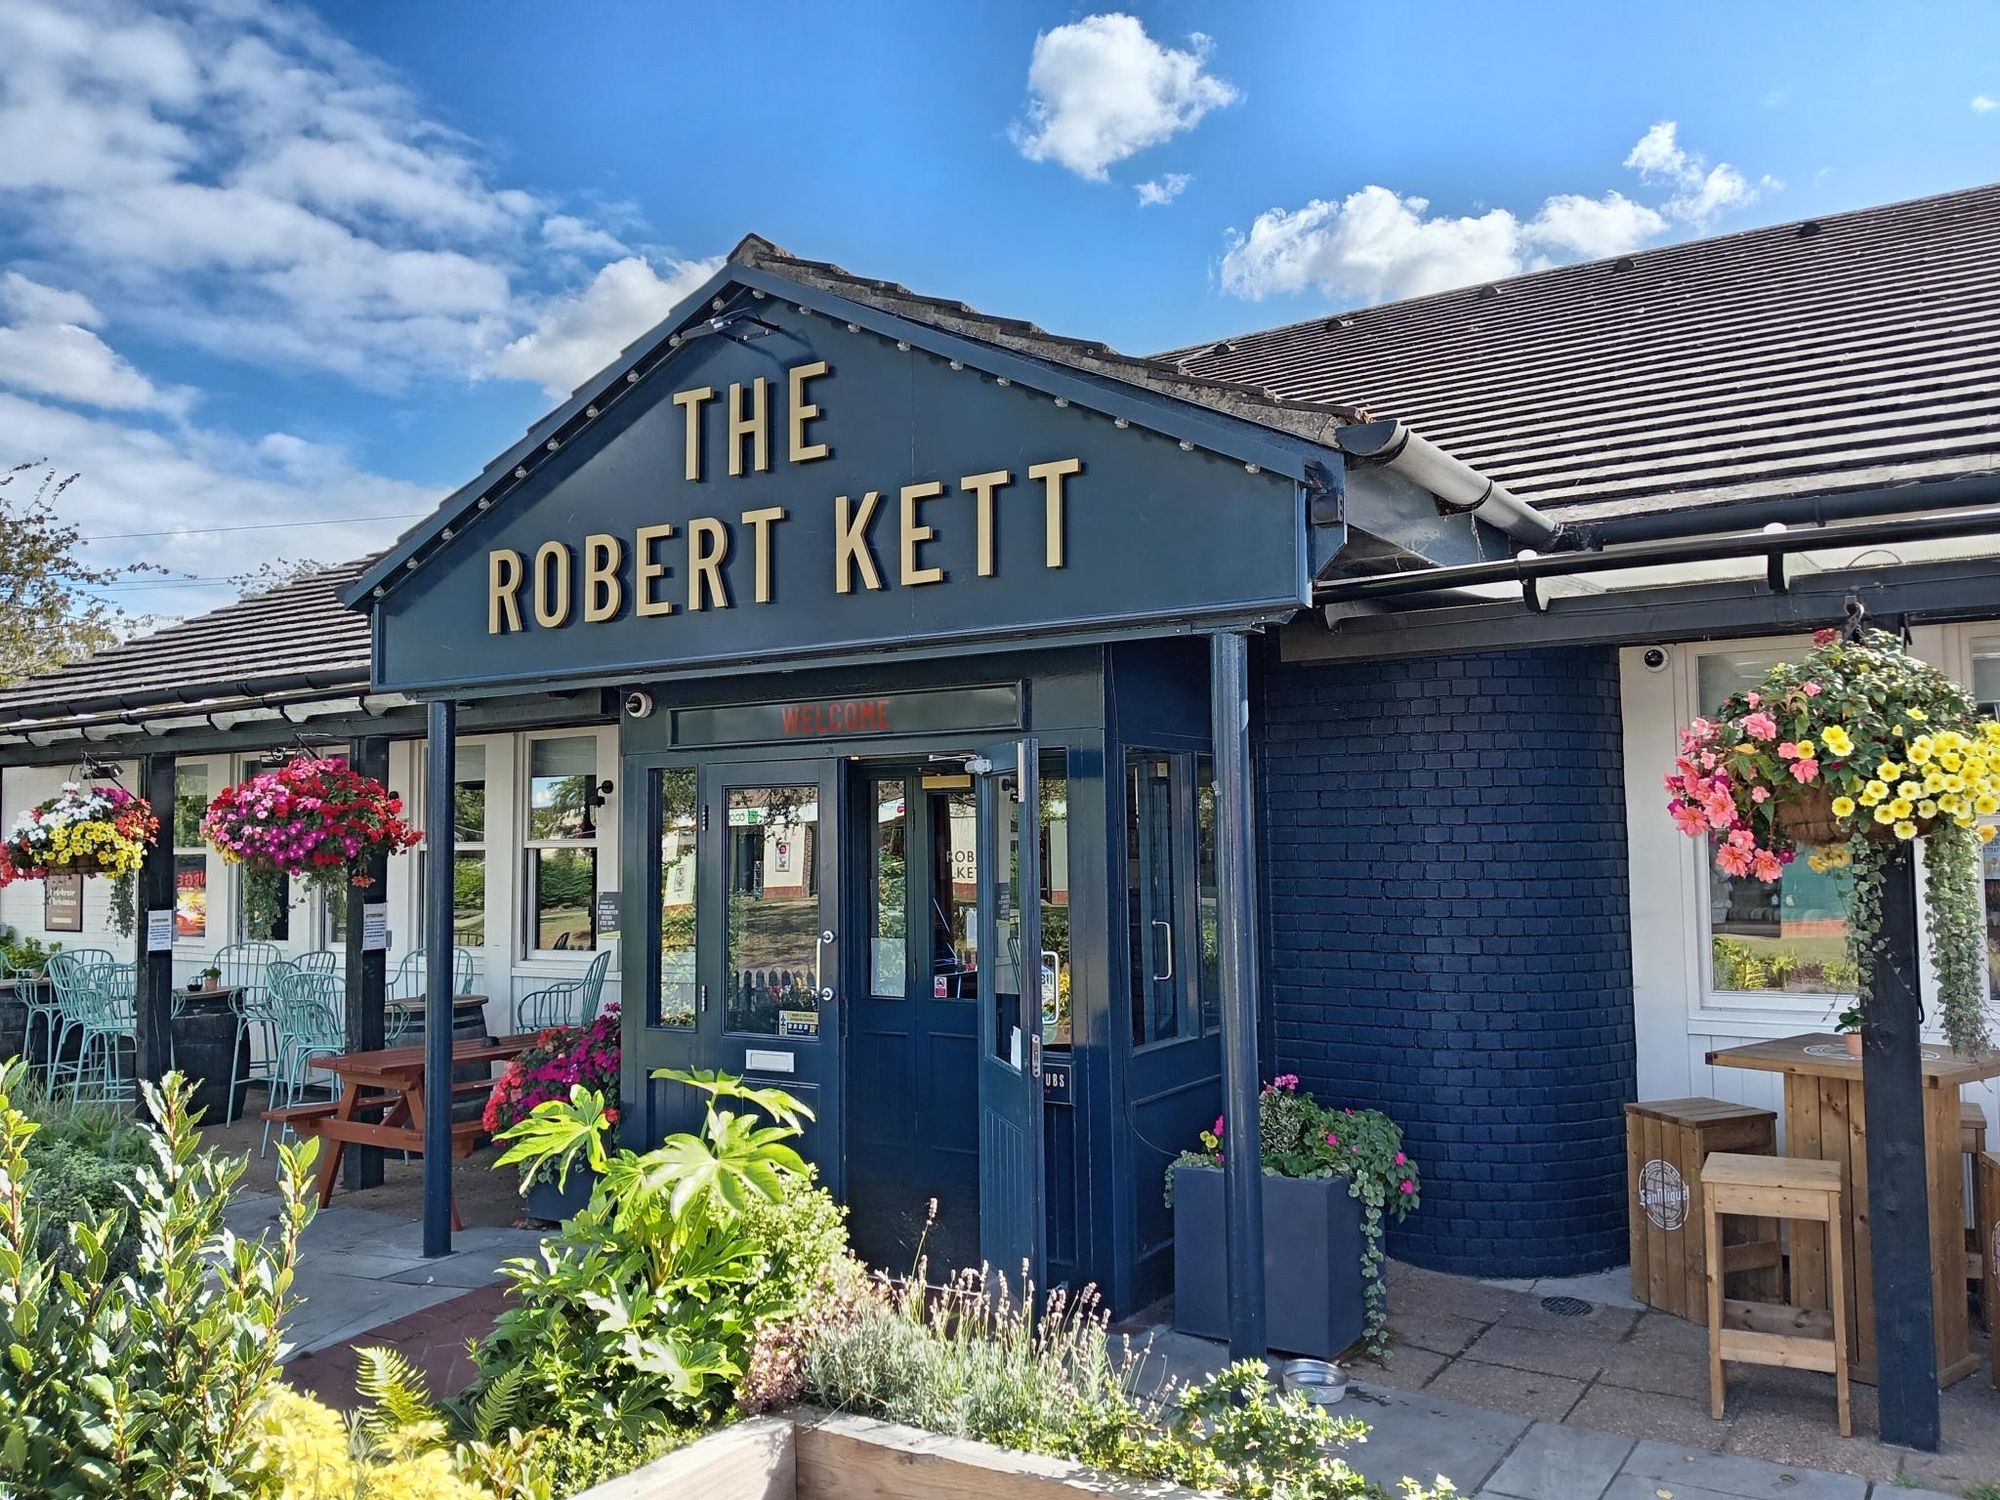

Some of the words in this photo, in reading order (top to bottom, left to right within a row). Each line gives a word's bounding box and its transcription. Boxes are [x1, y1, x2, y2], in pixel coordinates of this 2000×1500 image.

[673, 361, 829, 481] THE
[488, 506, 786, 635] ROBERT
[835, 458, 1082, 594] KETT
[782, 698, 892, 736] WELCOME
[956, 866, 978, 879] KE
[1043, 1072, 1065, 1088] UBS
